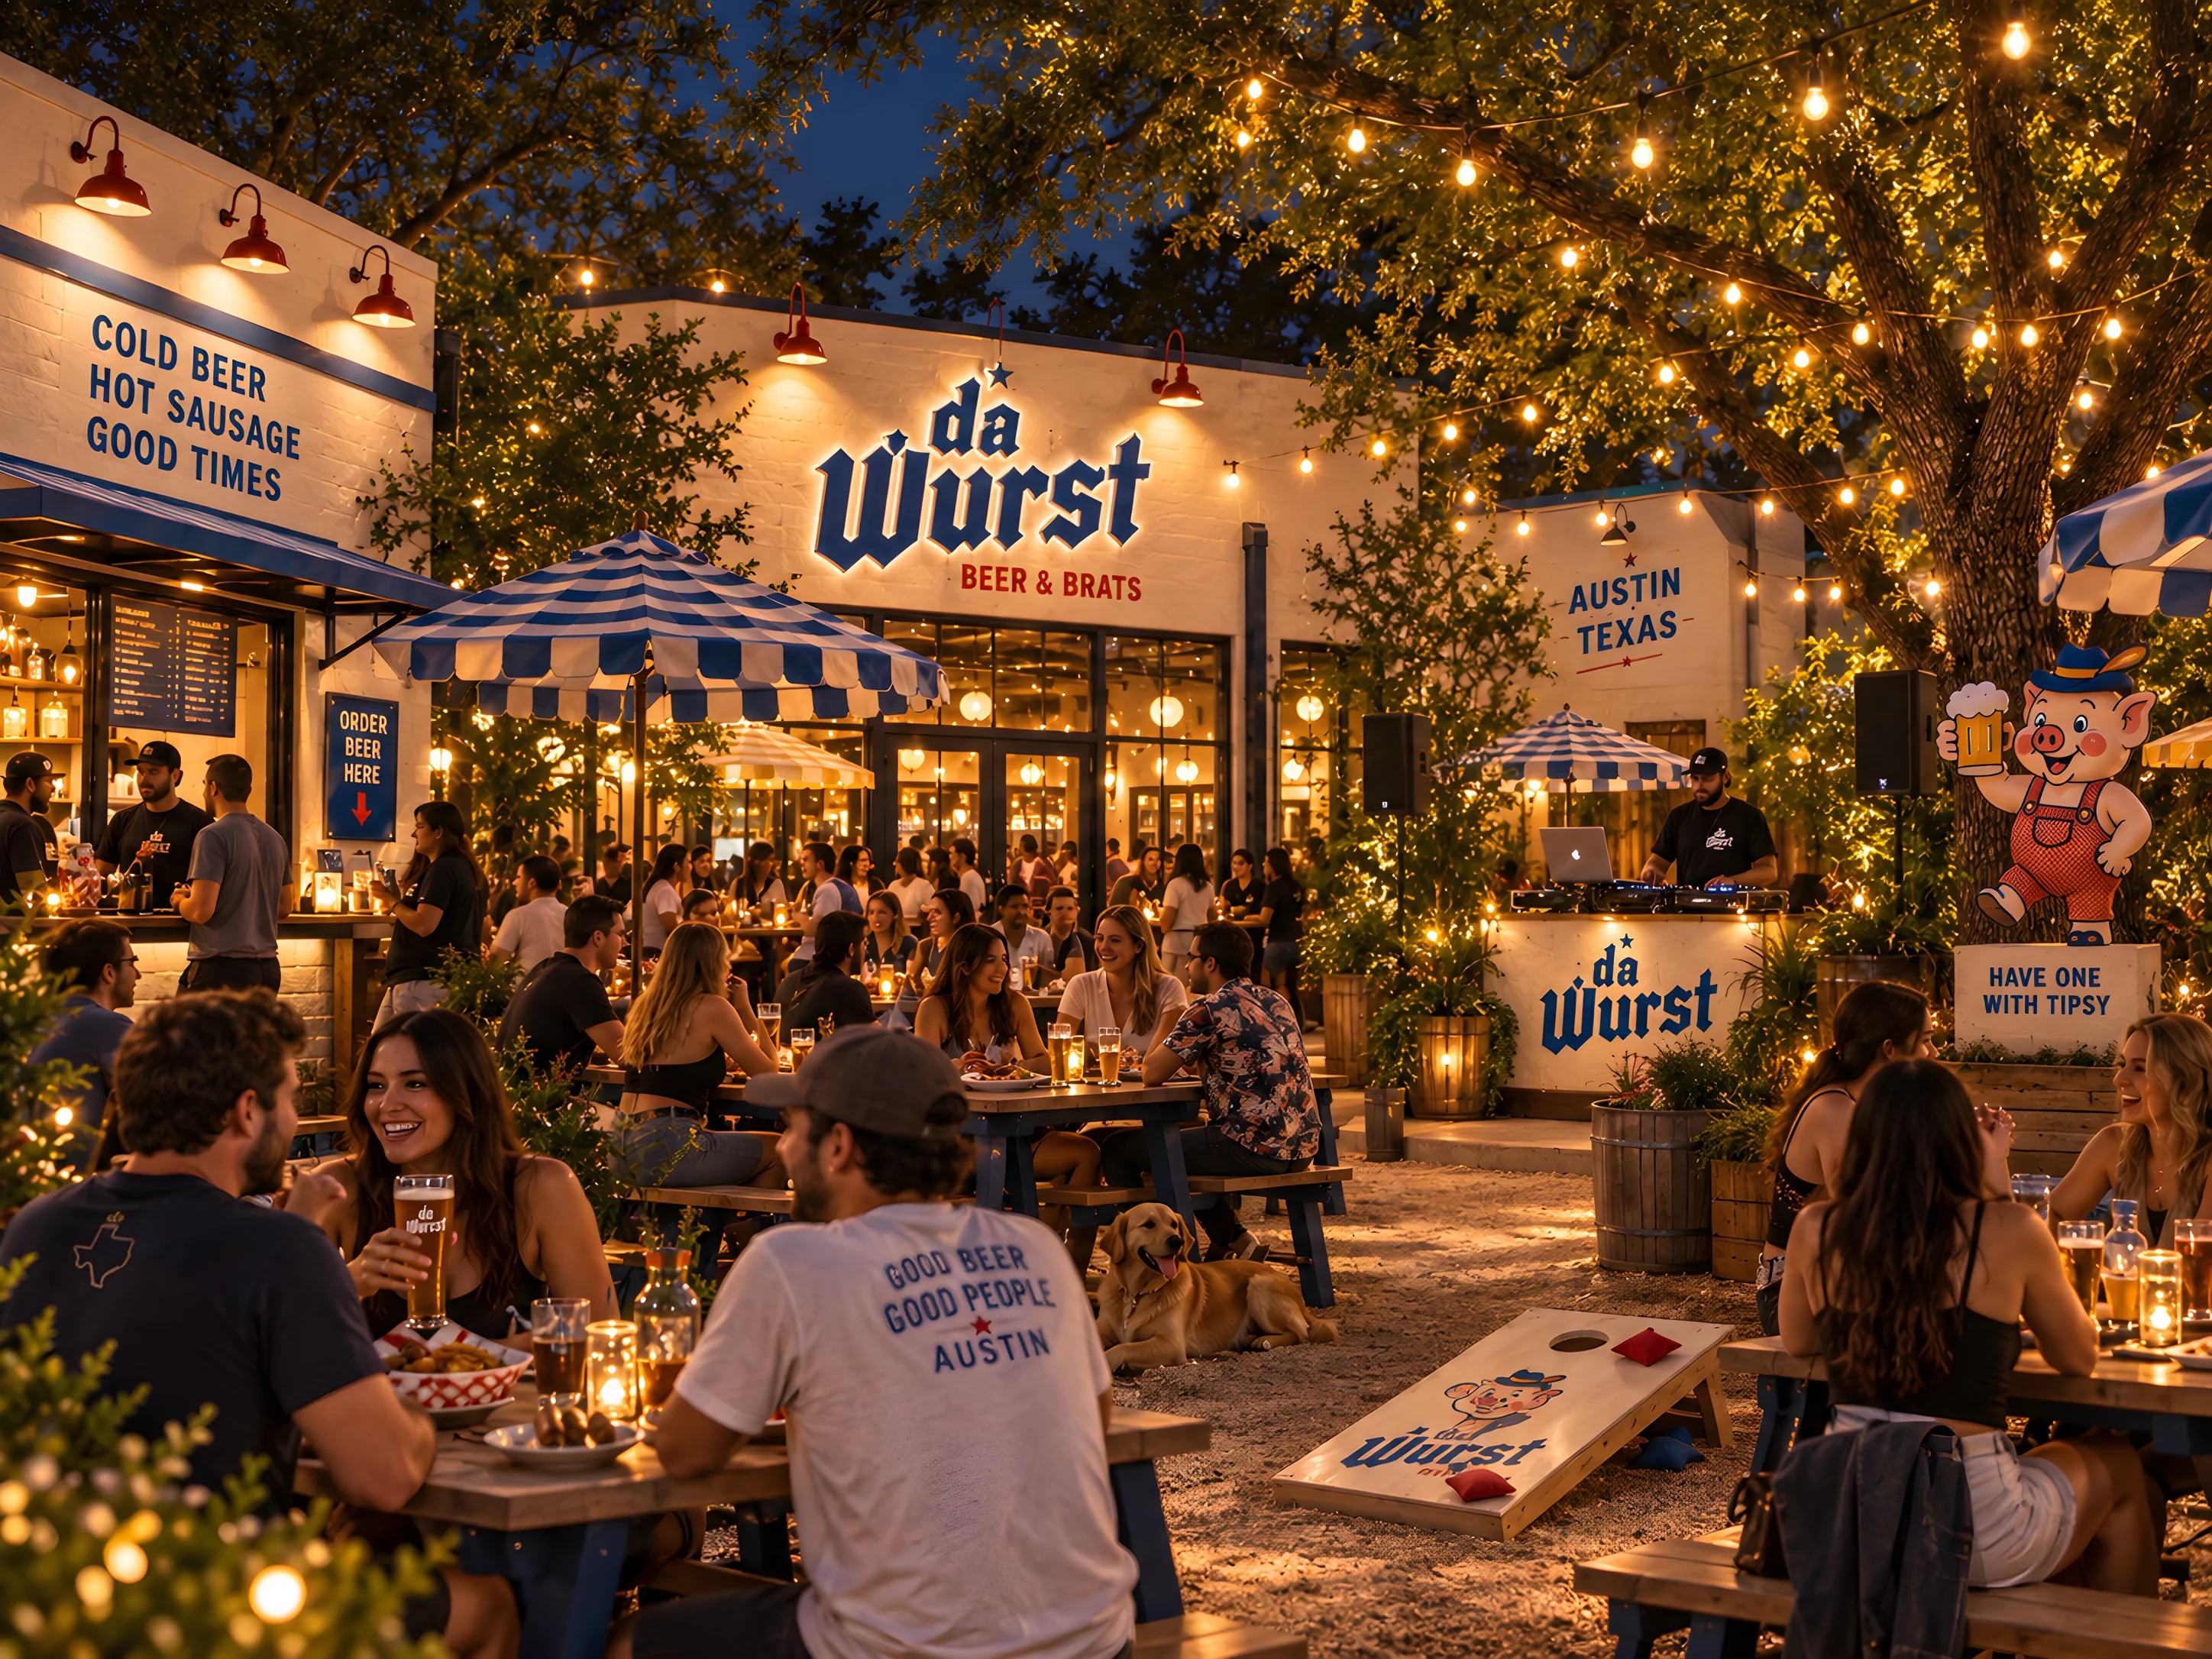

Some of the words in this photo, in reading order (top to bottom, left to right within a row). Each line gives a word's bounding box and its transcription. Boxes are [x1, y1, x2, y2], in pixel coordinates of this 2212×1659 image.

[92, 314, 177, 370] COLD
[192, 345, 266, 403] BEER
[90, 363, 155, 415] HOT
[167, 389, 300, 461] SAUSAGE
[927, 377, 1020, 458] da
[87, 416, 177, 471] GOOD
[191, 445, 281, 501] TIMES
[814, 428, 1150, 574] Wurst
[961, 564, 1027, 593] BEER
[1036, 570, 1053, 595] &
[1063, 571, 1142, 601] BRATS
[1568, 567, 1680, 615] AUSTIN
[1577, 610, 1677, 655] TEXAS
[340, 710, 387, 735] ORDER
[345, 736, 381, 759] BEER
[344, 762, 380, 784] HERE
[1593, 943, 1638, 988] da
[1990, 967, 2046, 988] HAVE
[2055, 967, 2100, 988] ONE
[1540, 968, 1718, 1056] Wurst
[1983, 994, 2038, 1014] WITH
[2047, 994, 2110, 1016] TIPSY
[884, 1250, 952, 1290] GOOD
[957, 1245, 1028, 1273] BEER
[884, 1287, 958, 1334] GOOD
[962, 1278, 1056, 1311] PEOPLE
[934, 1329, 1050, 1373] AUSTIN
[1340, 1426, 1547, 1468] Wurst
